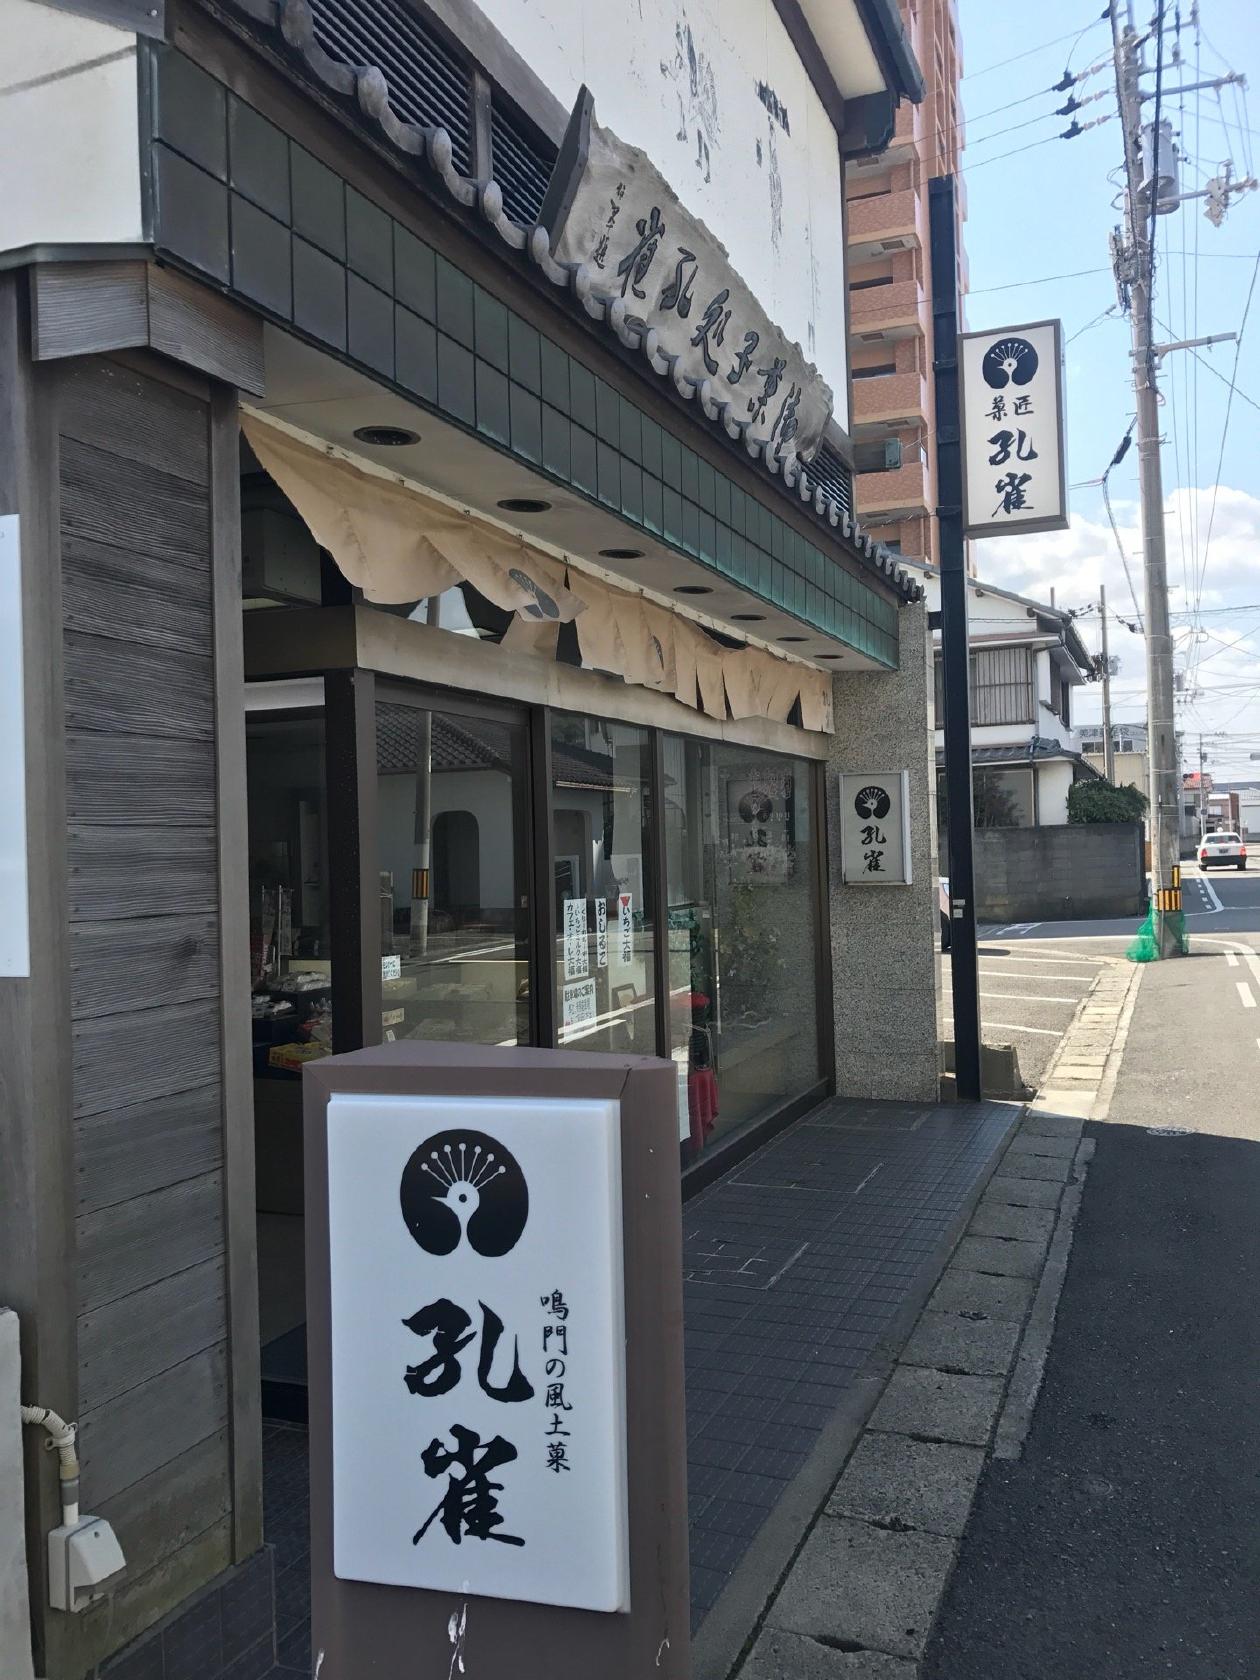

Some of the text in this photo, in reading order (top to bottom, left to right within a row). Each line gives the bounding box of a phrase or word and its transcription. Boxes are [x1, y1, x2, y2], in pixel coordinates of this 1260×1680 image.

[985, 395, 1034, 421] 菓匠
[987, 428, 1039, 518] 孔雀
[859, 825, 887, 874] 孔雀
[597, 900, 607, 966] おしるこ
[622, 906, 632, 963] いちご大福
[540, 1288, 574, 1473] 鳴門の風土菓
[402, 1298, 534, 1546] 孔雀
